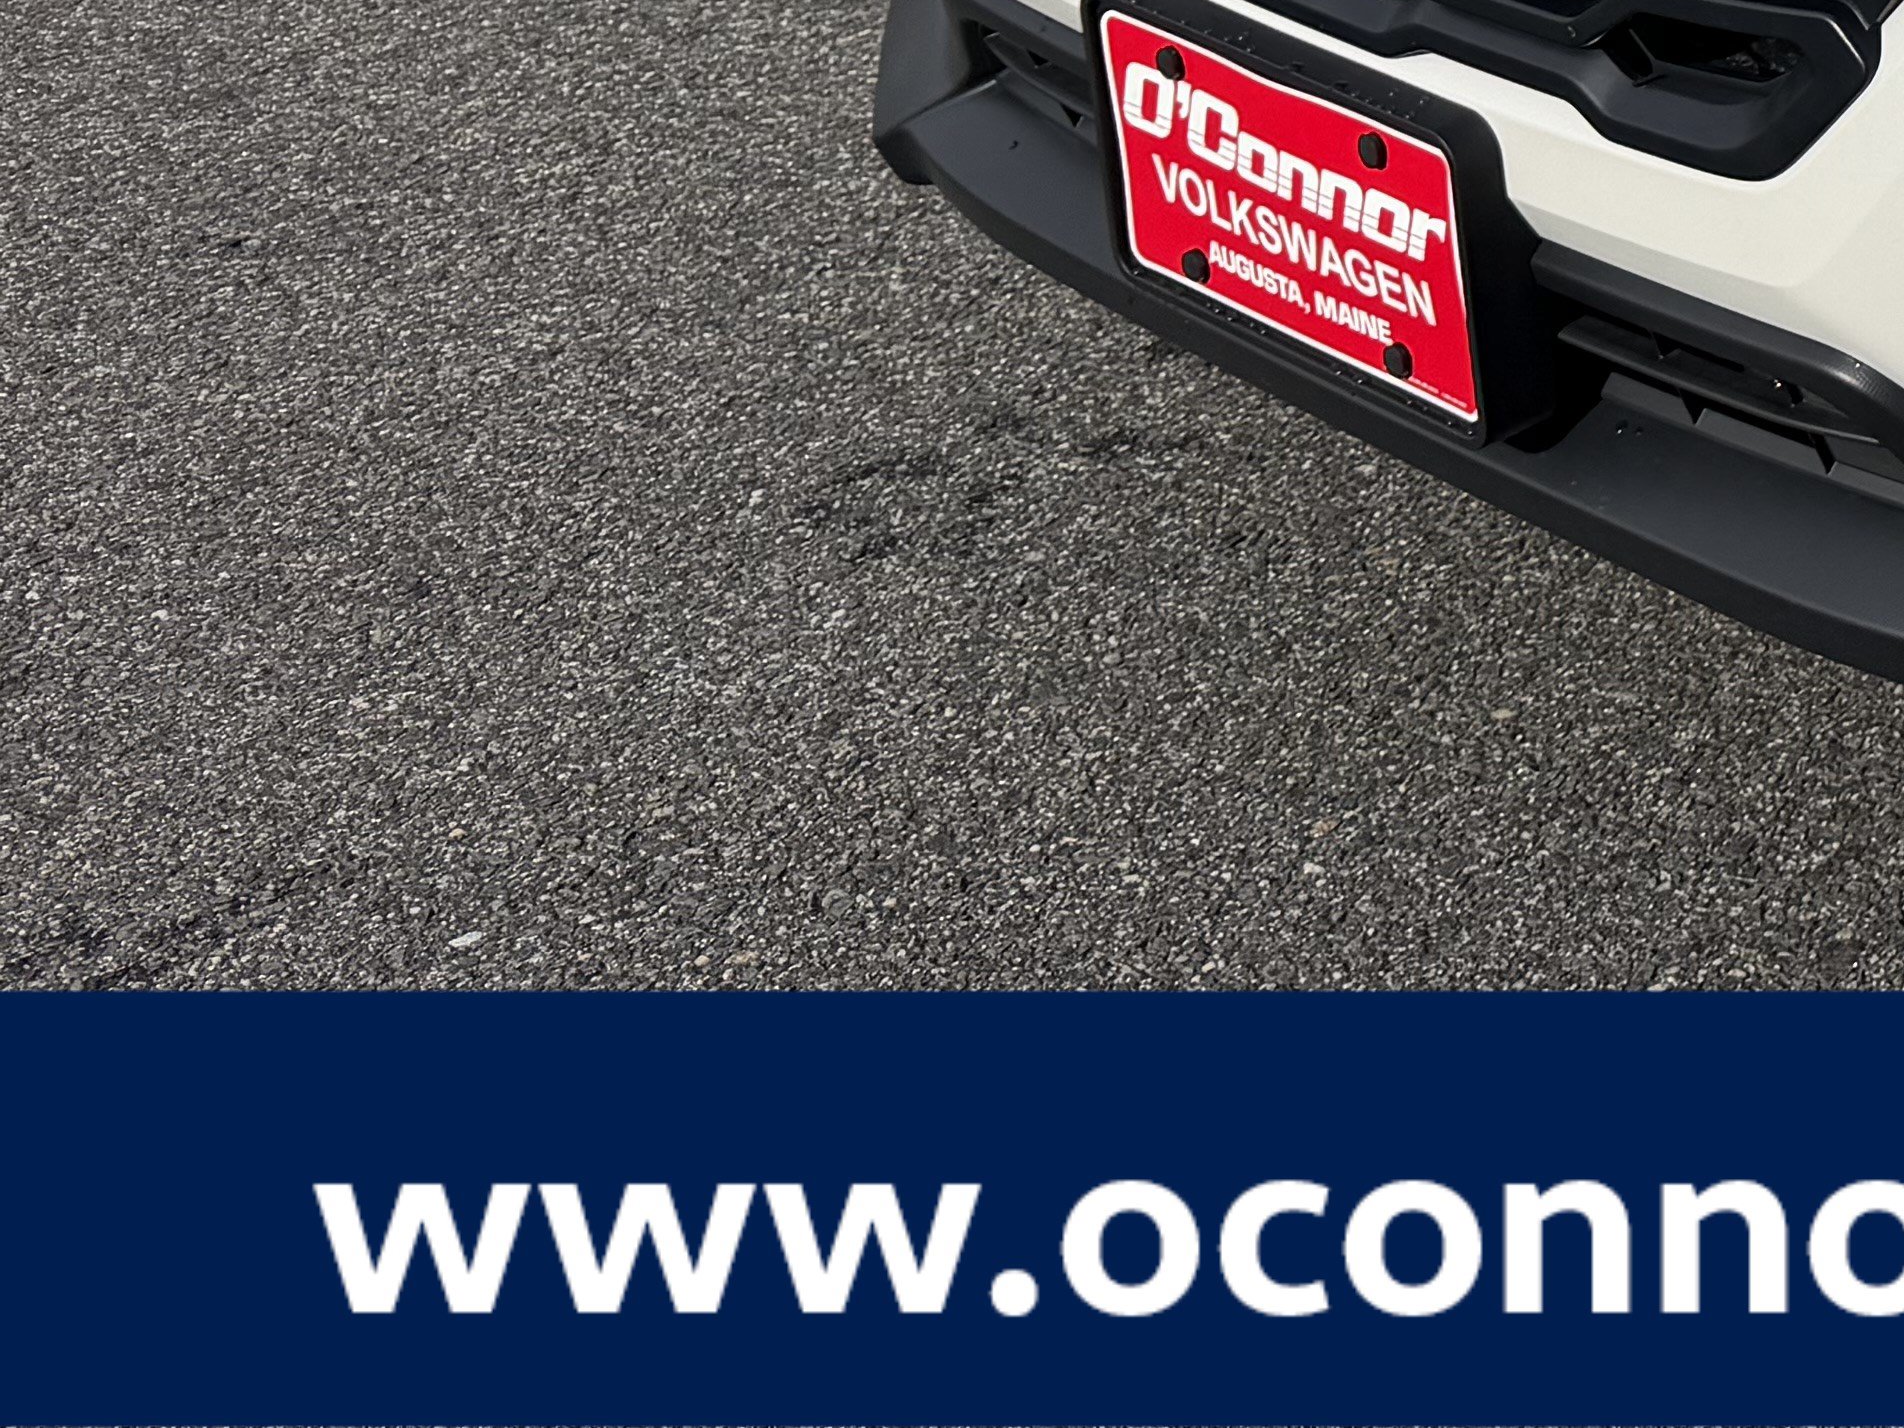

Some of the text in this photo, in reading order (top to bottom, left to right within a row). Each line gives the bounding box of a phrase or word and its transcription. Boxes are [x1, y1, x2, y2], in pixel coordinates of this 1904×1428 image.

[1123, 62, 1446, 262] O'Connor
[1152, 153, 1437, 327] VOLKSWAGEN
[1209, 241, 1394, 345] AUGUSTA, MAINE
